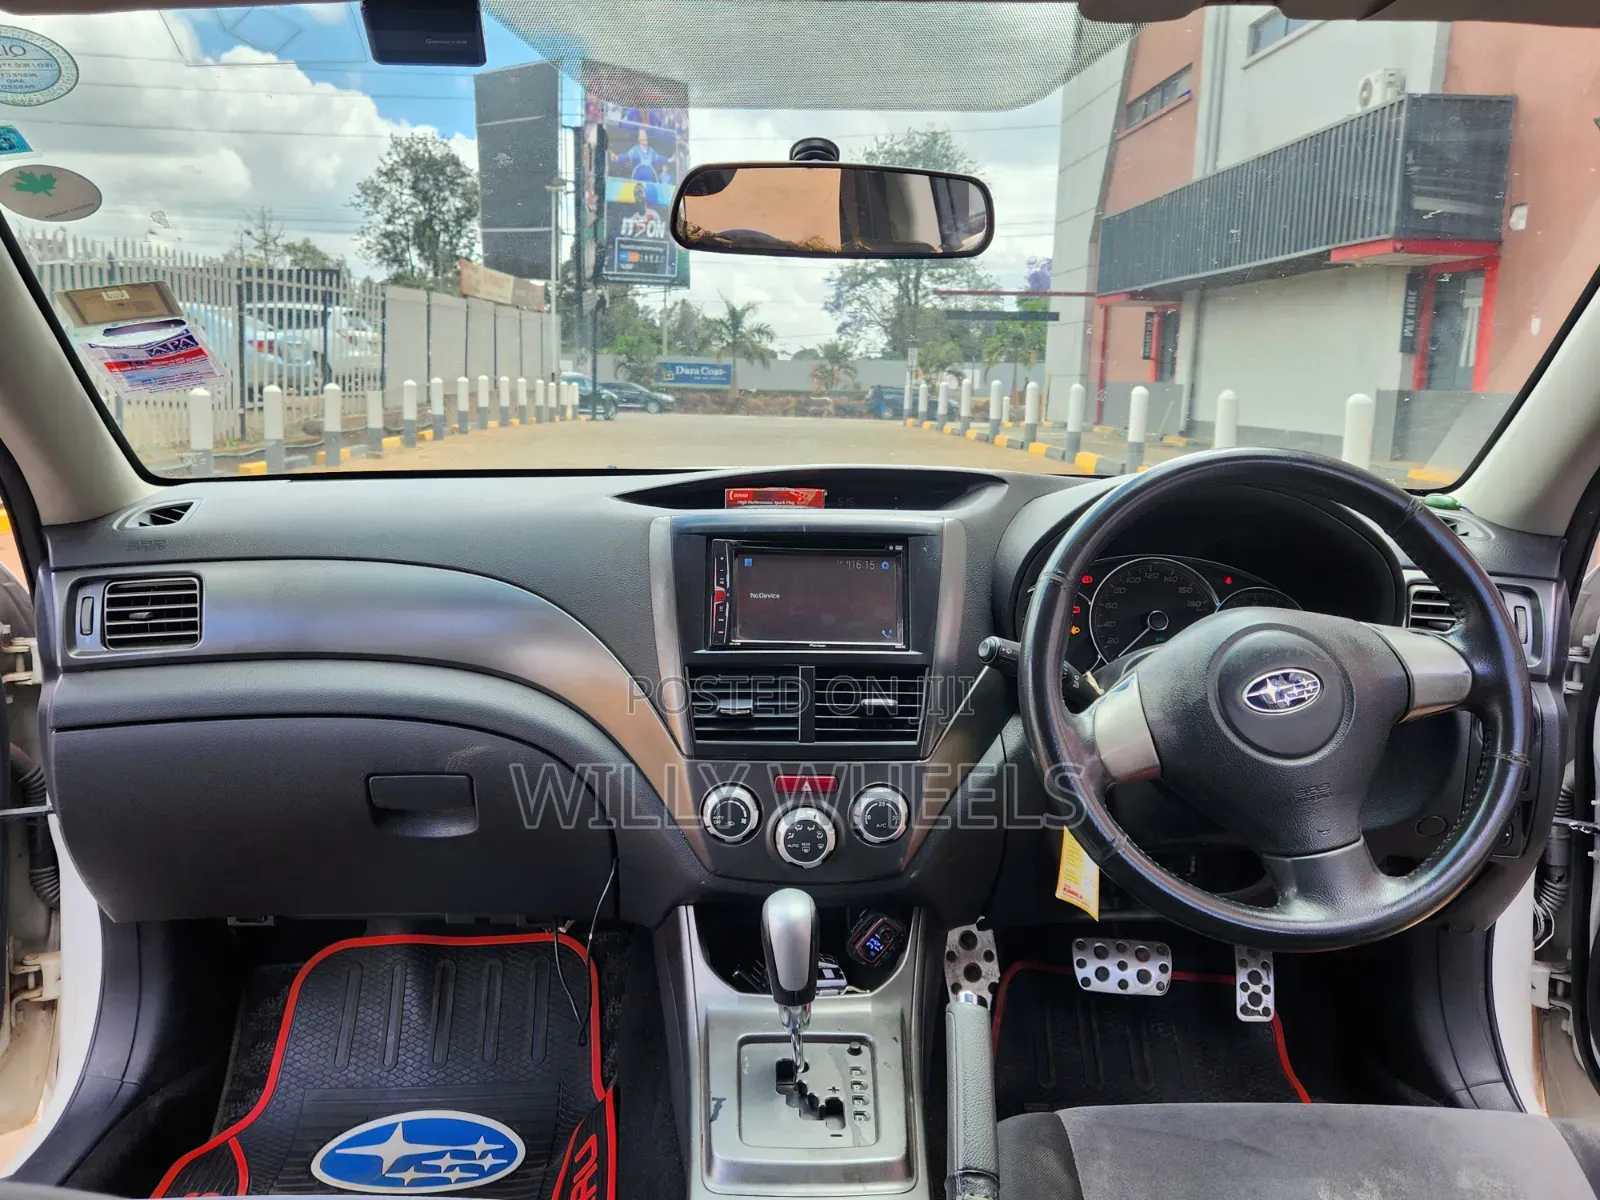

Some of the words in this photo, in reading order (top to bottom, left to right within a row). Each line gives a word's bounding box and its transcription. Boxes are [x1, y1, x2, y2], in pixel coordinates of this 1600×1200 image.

[1406, 290, 1418, 315] HERE
[1403, 319, 1415, 336] PAY
[151, 338, 196, 355] APA
